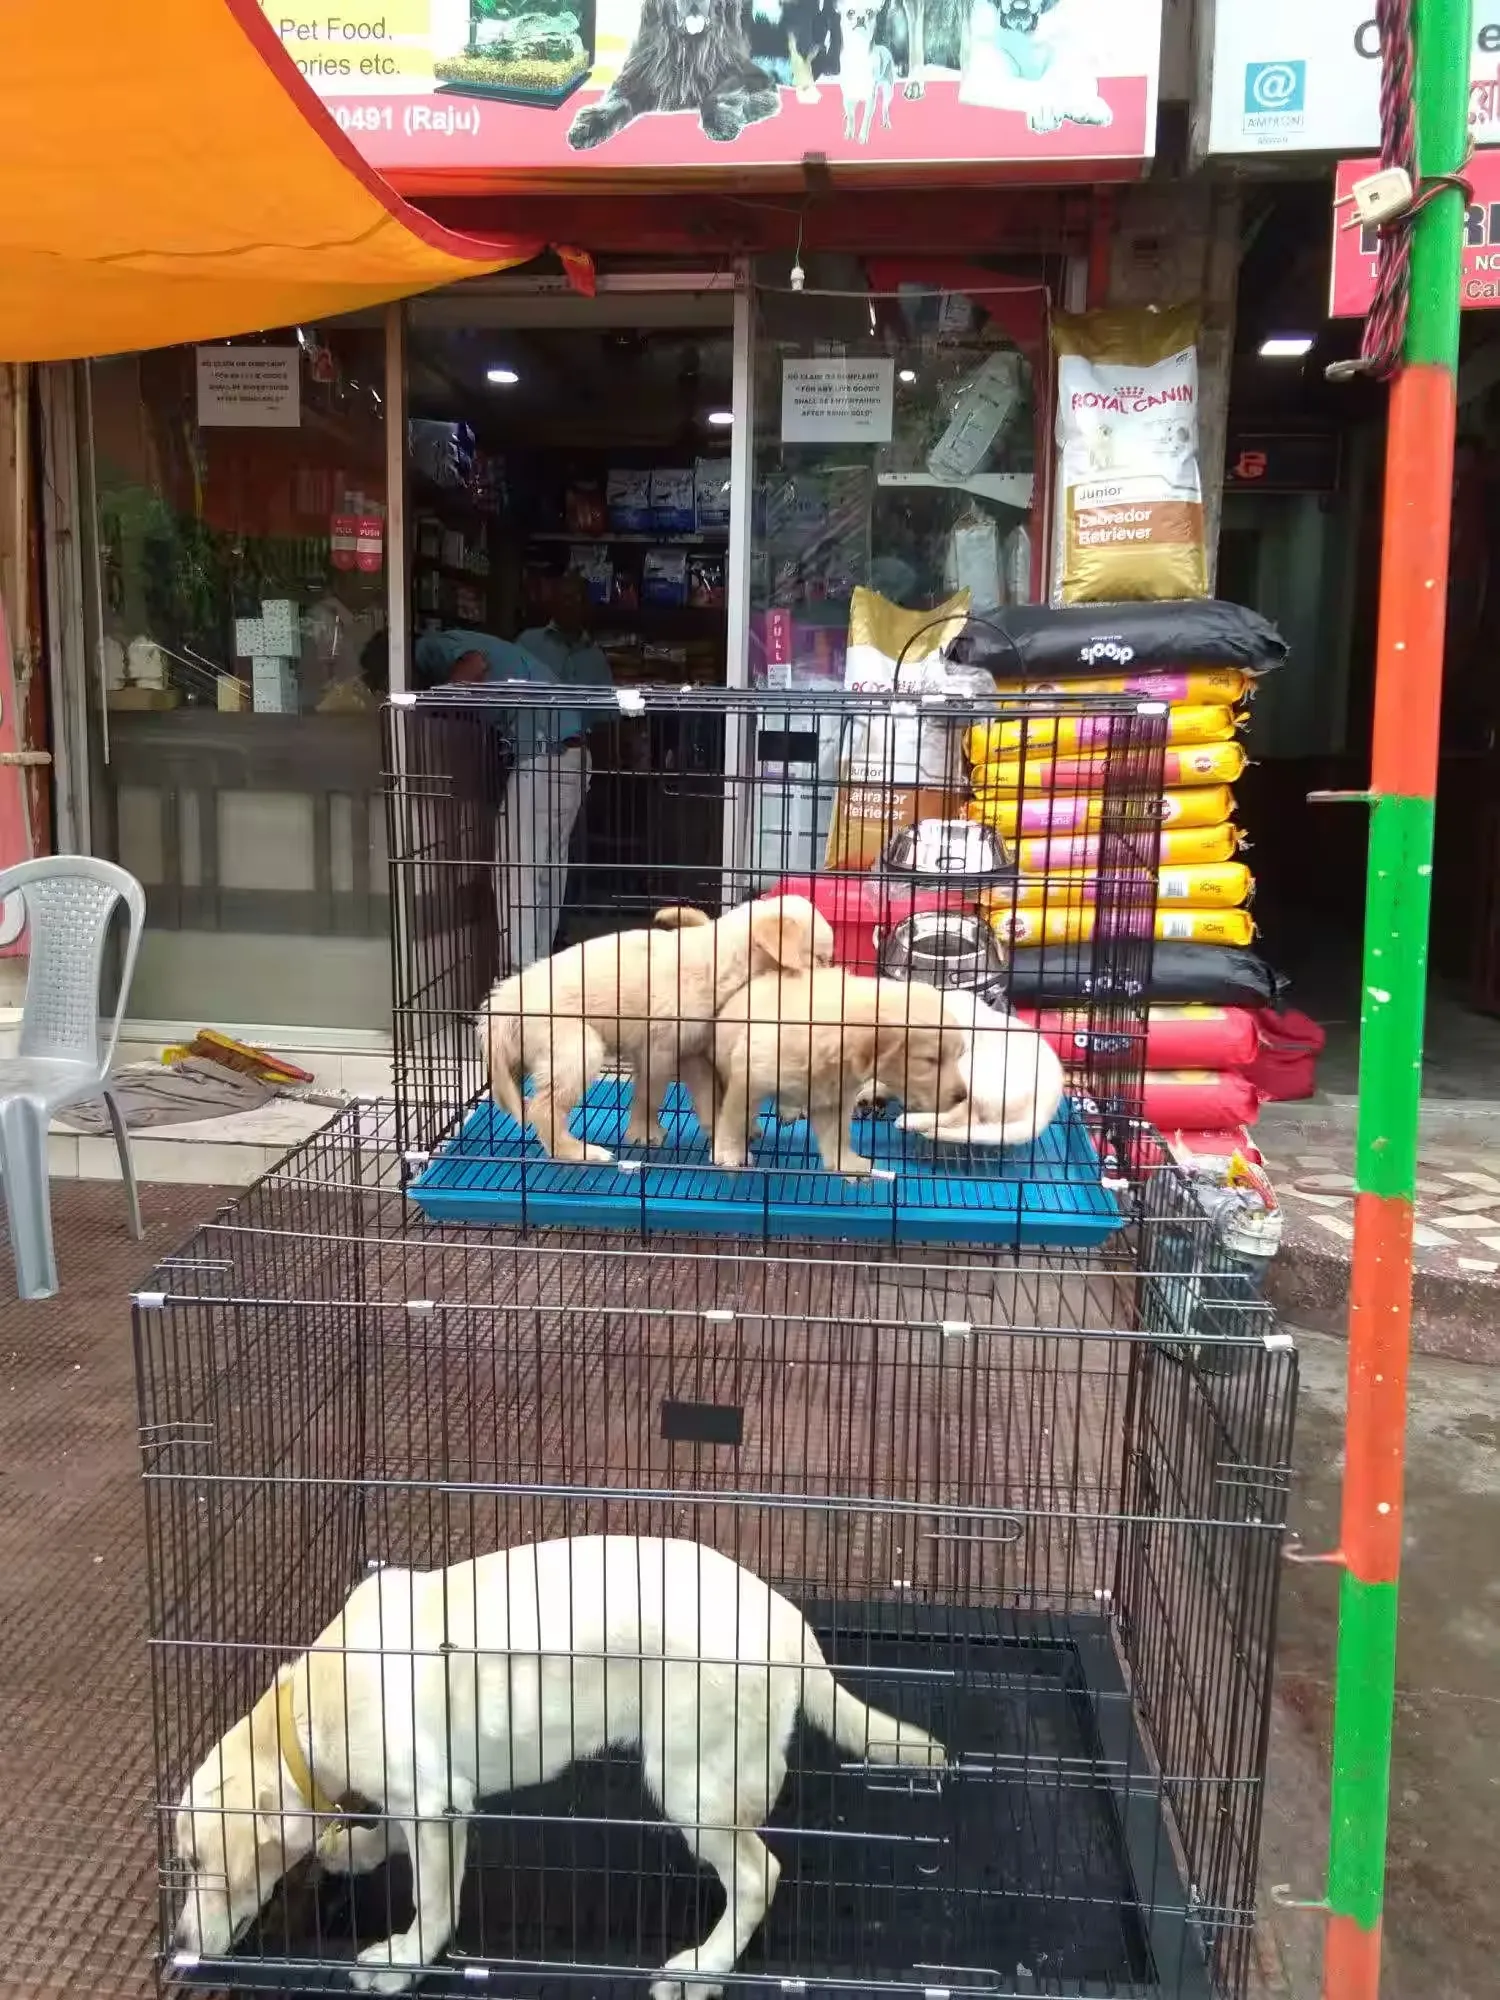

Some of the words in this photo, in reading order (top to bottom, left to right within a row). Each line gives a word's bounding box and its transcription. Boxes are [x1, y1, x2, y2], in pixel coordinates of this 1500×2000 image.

[280, 18, 318, 40] Pet
[297, 53, 351, 76] ories
[360, 53, 401, 75] etc.
[403, 104, 481, 136] (Raju)
[1071, 391, 1129, 415] ROYAL
[1132, 384, 1193, 413] CANIN
[1079, 485, 1123, 501] Junior
[1079, 642, 1134, 666] drools
